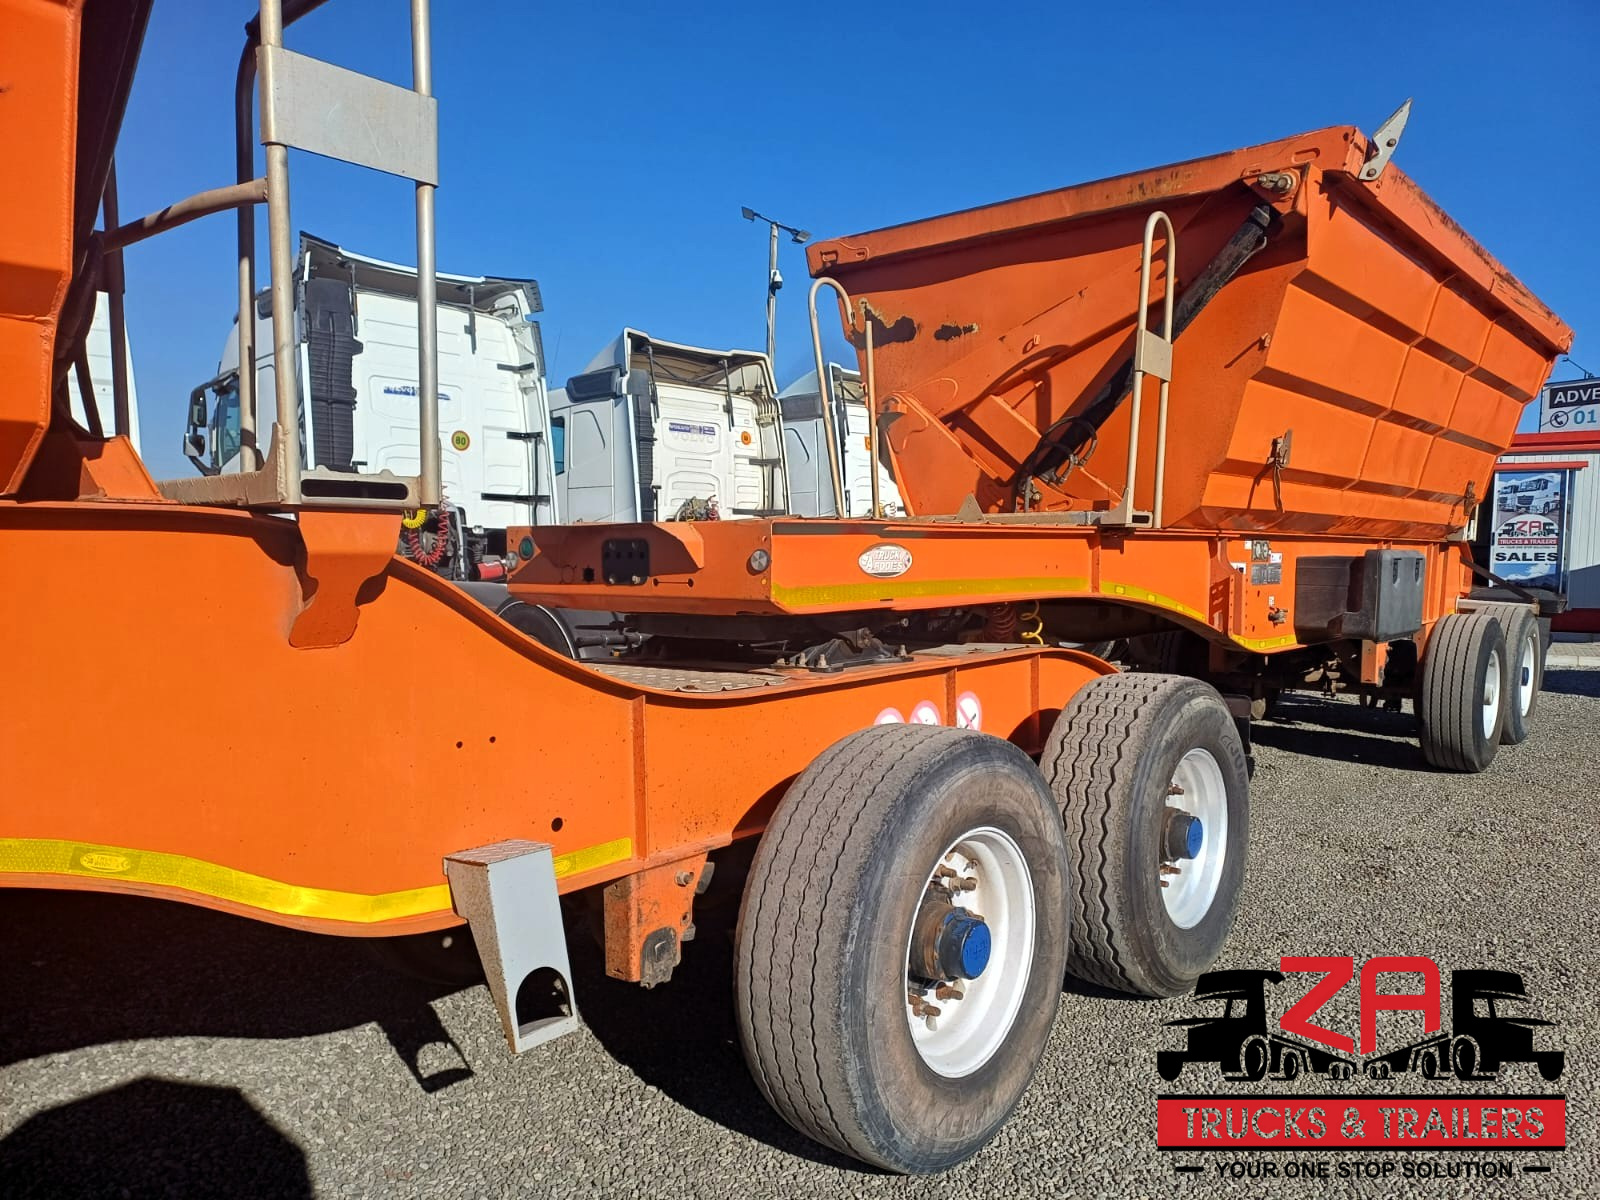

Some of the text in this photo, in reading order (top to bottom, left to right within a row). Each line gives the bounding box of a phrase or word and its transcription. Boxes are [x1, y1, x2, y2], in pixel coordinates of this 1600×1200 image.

[1574, 409, 1597, 424] 01
[455, 436, 466, 446] 80
[1516, 521, 1542, 534] ZA
[873, 549, 902, 560] TRUCK
[1495, 552, 1559, 562] SALES
